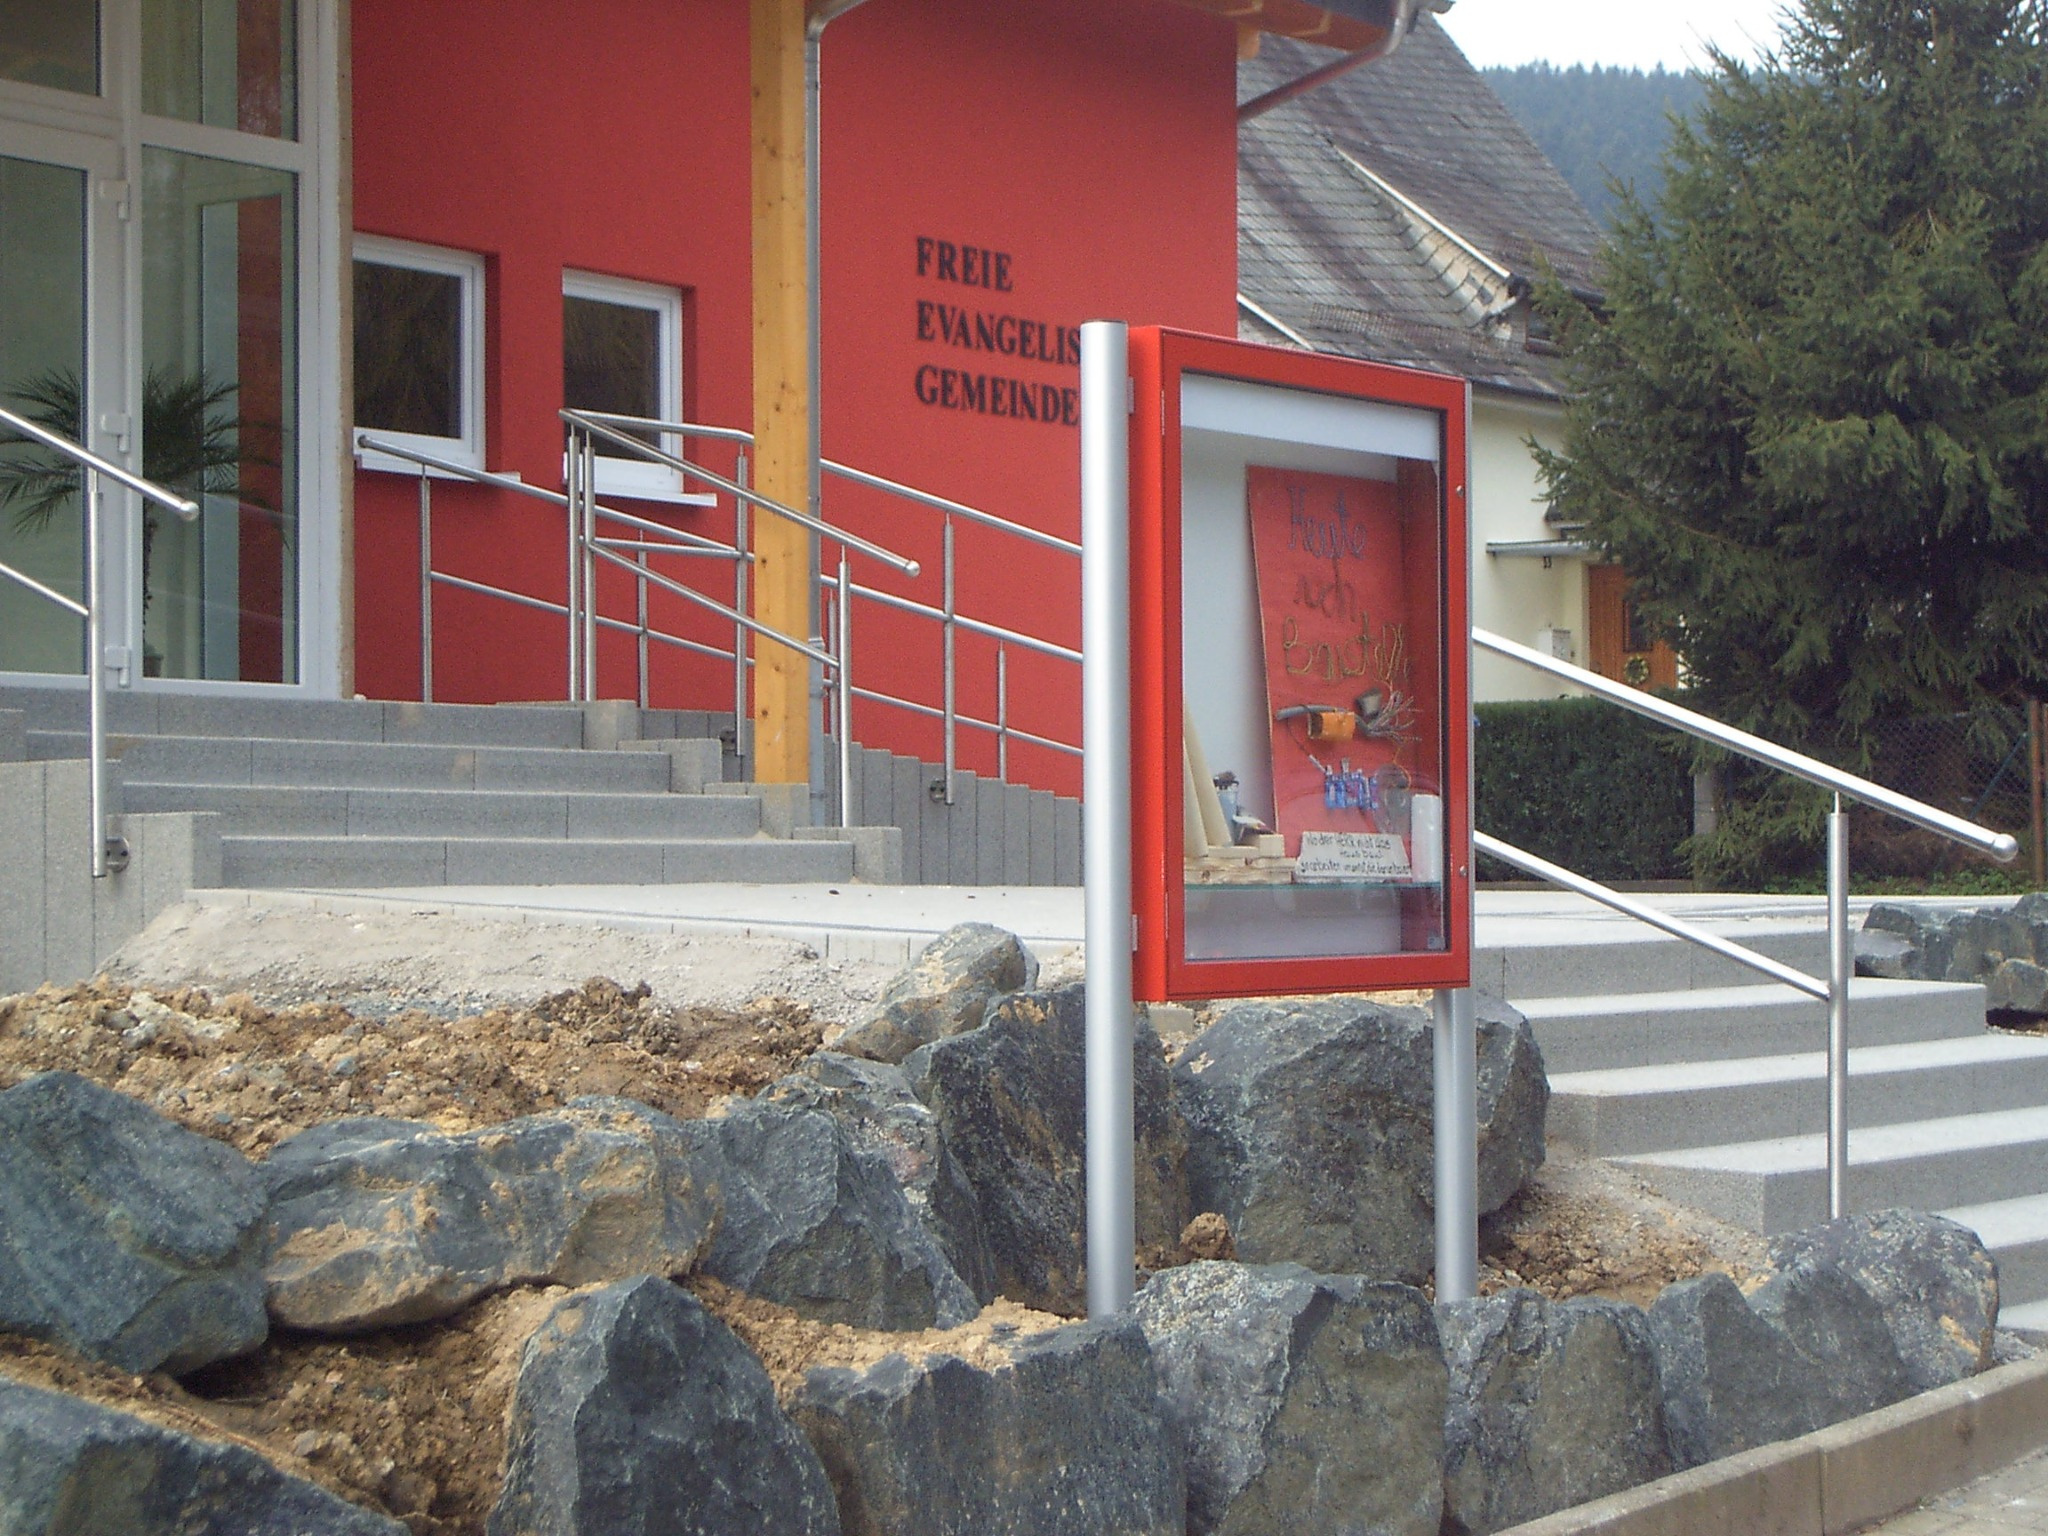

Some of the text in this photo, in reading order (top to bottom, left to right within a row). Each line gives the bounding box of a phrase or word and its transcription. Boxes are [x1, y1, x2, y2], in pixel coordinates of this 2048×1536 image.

[916, 236, 1013, 292] FREIE
[916, 299, 1081, 366] EVANGELIS
[914, 363, 1079, 427] GEMEINDE
